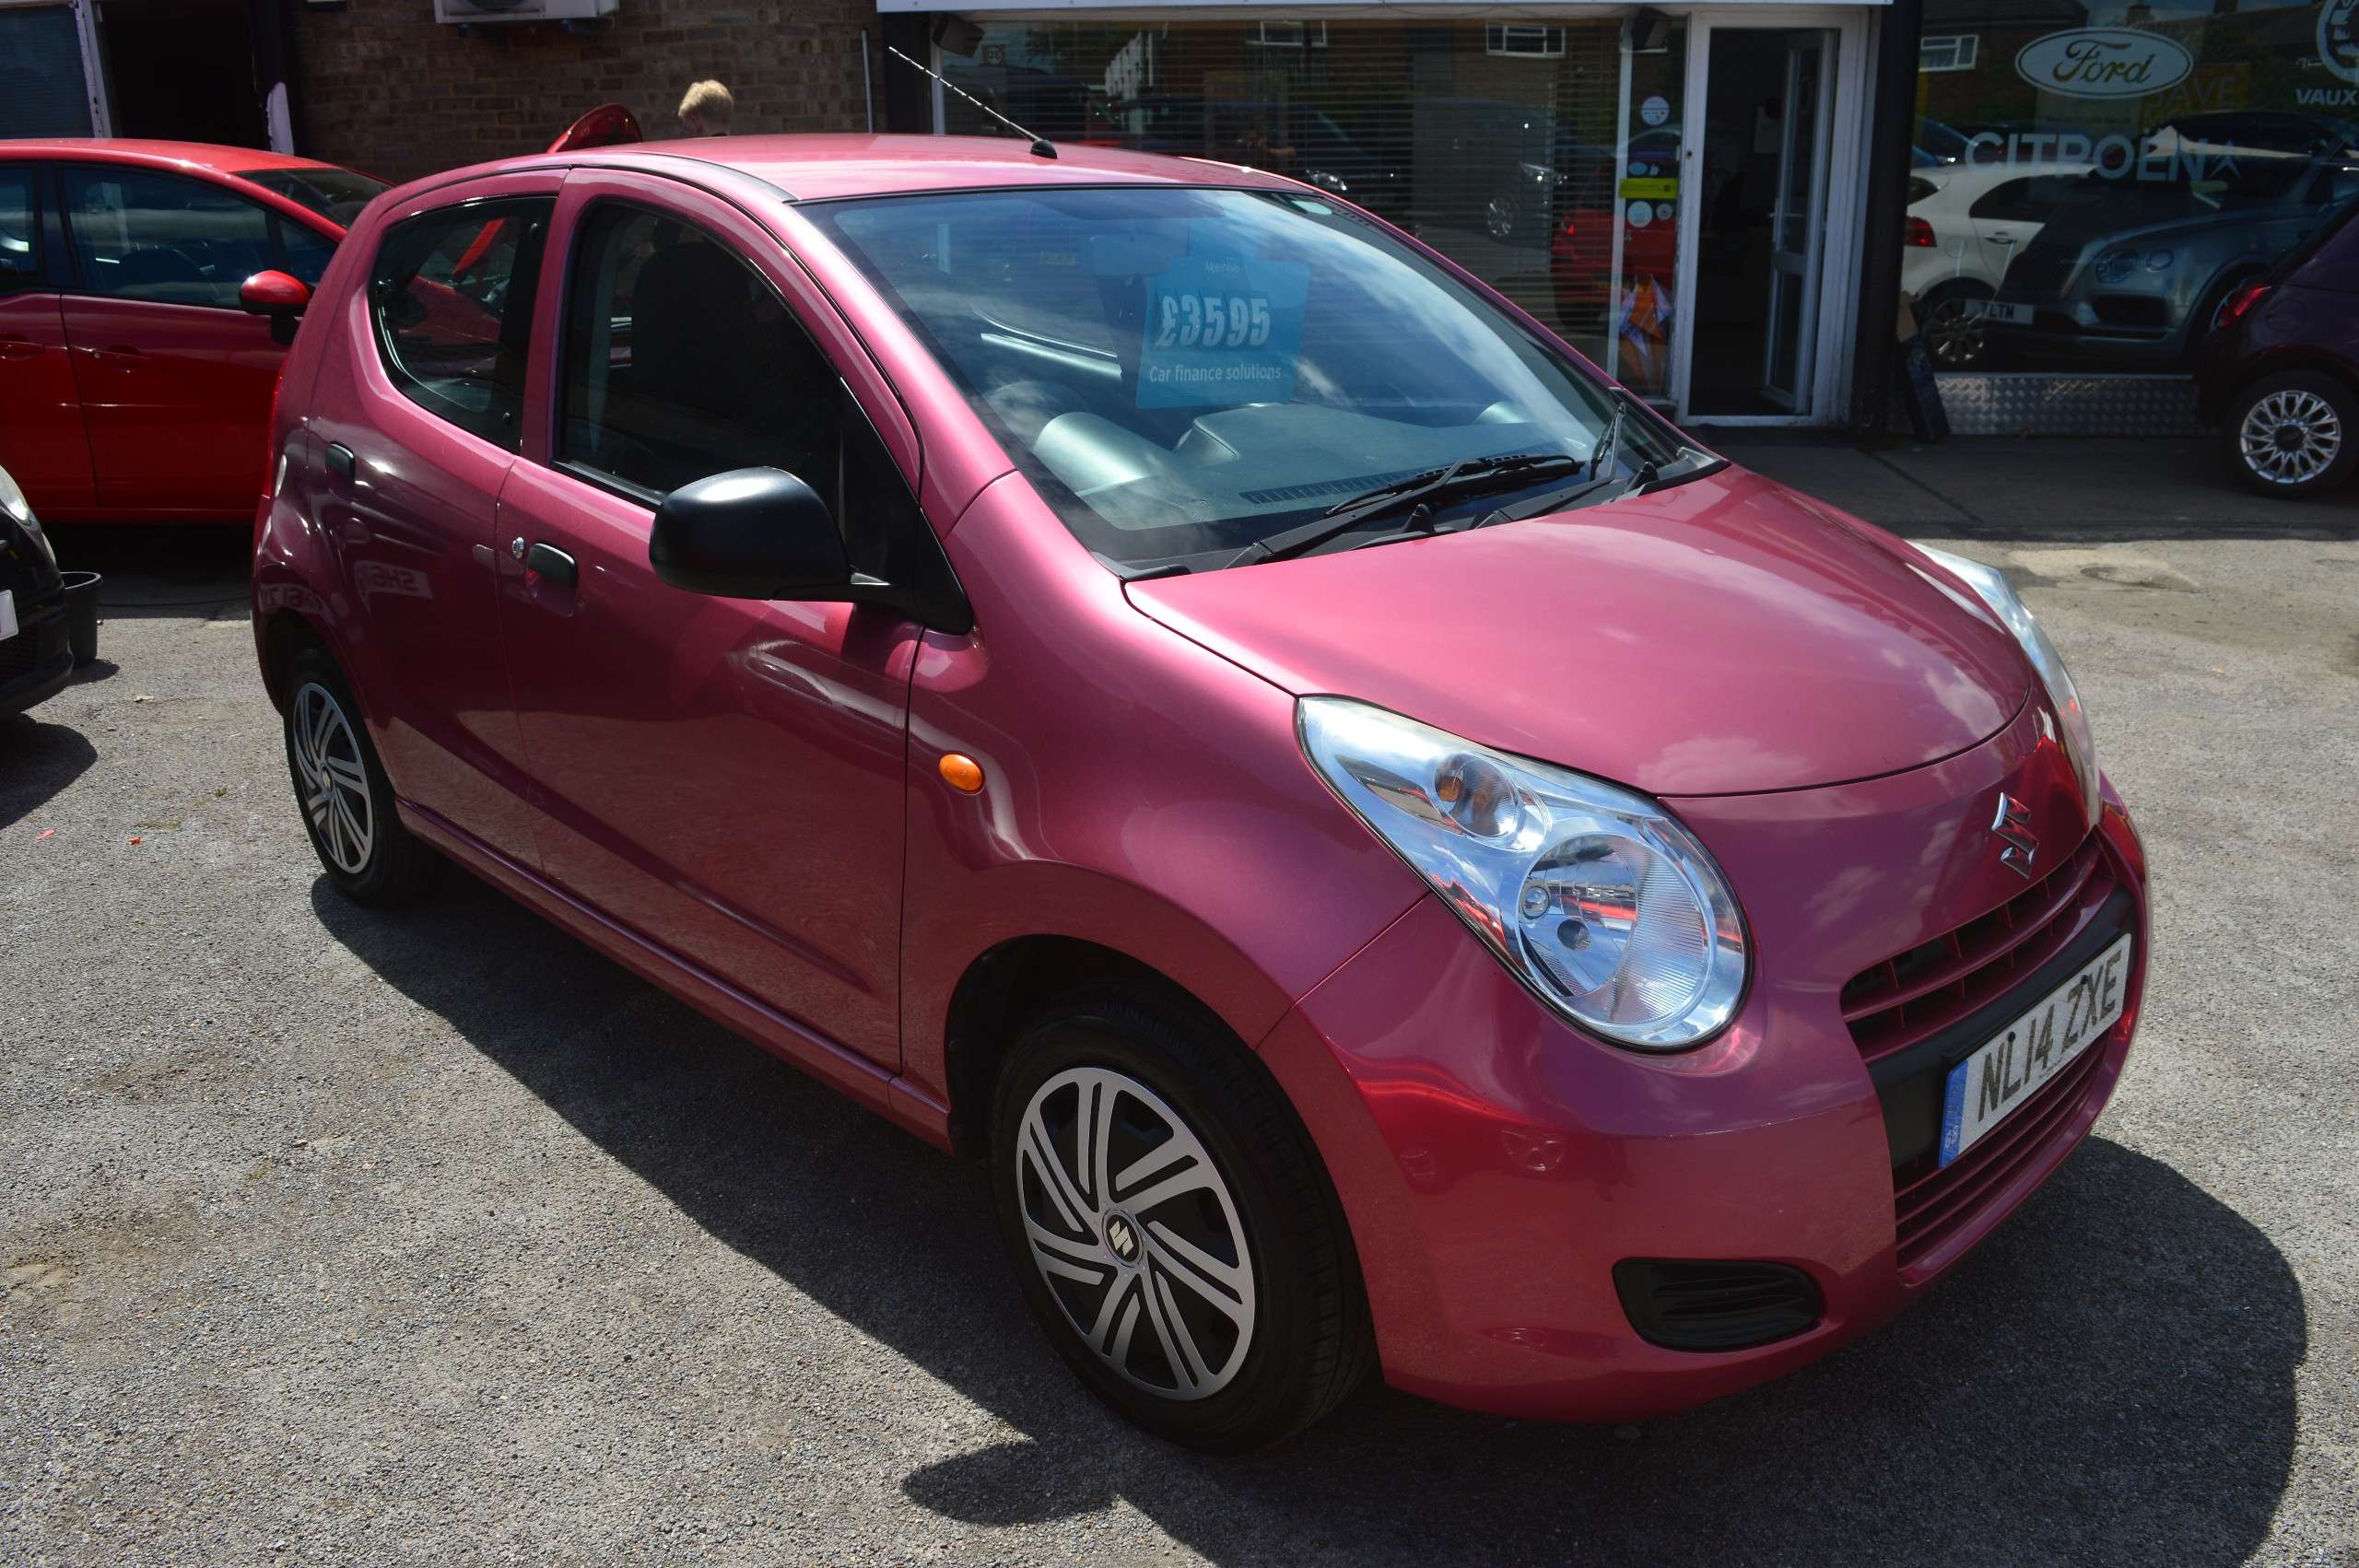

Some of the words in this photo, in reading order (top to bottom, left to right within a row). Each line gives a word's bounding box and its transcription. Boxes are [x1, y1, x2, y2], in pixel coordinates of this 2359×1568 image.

[2053, 39, 2154, 84] Ford
[1156, 294, 1271, 347] £3595
[1149, 366, 1171, 382] Car
[1175, 364, 1222, 382] finance
[1226, 363, 1282, 381] solutions
[1978, 1005, 2054, 1123] NL14
[2061, 949, 2122, 1057] ZXE
